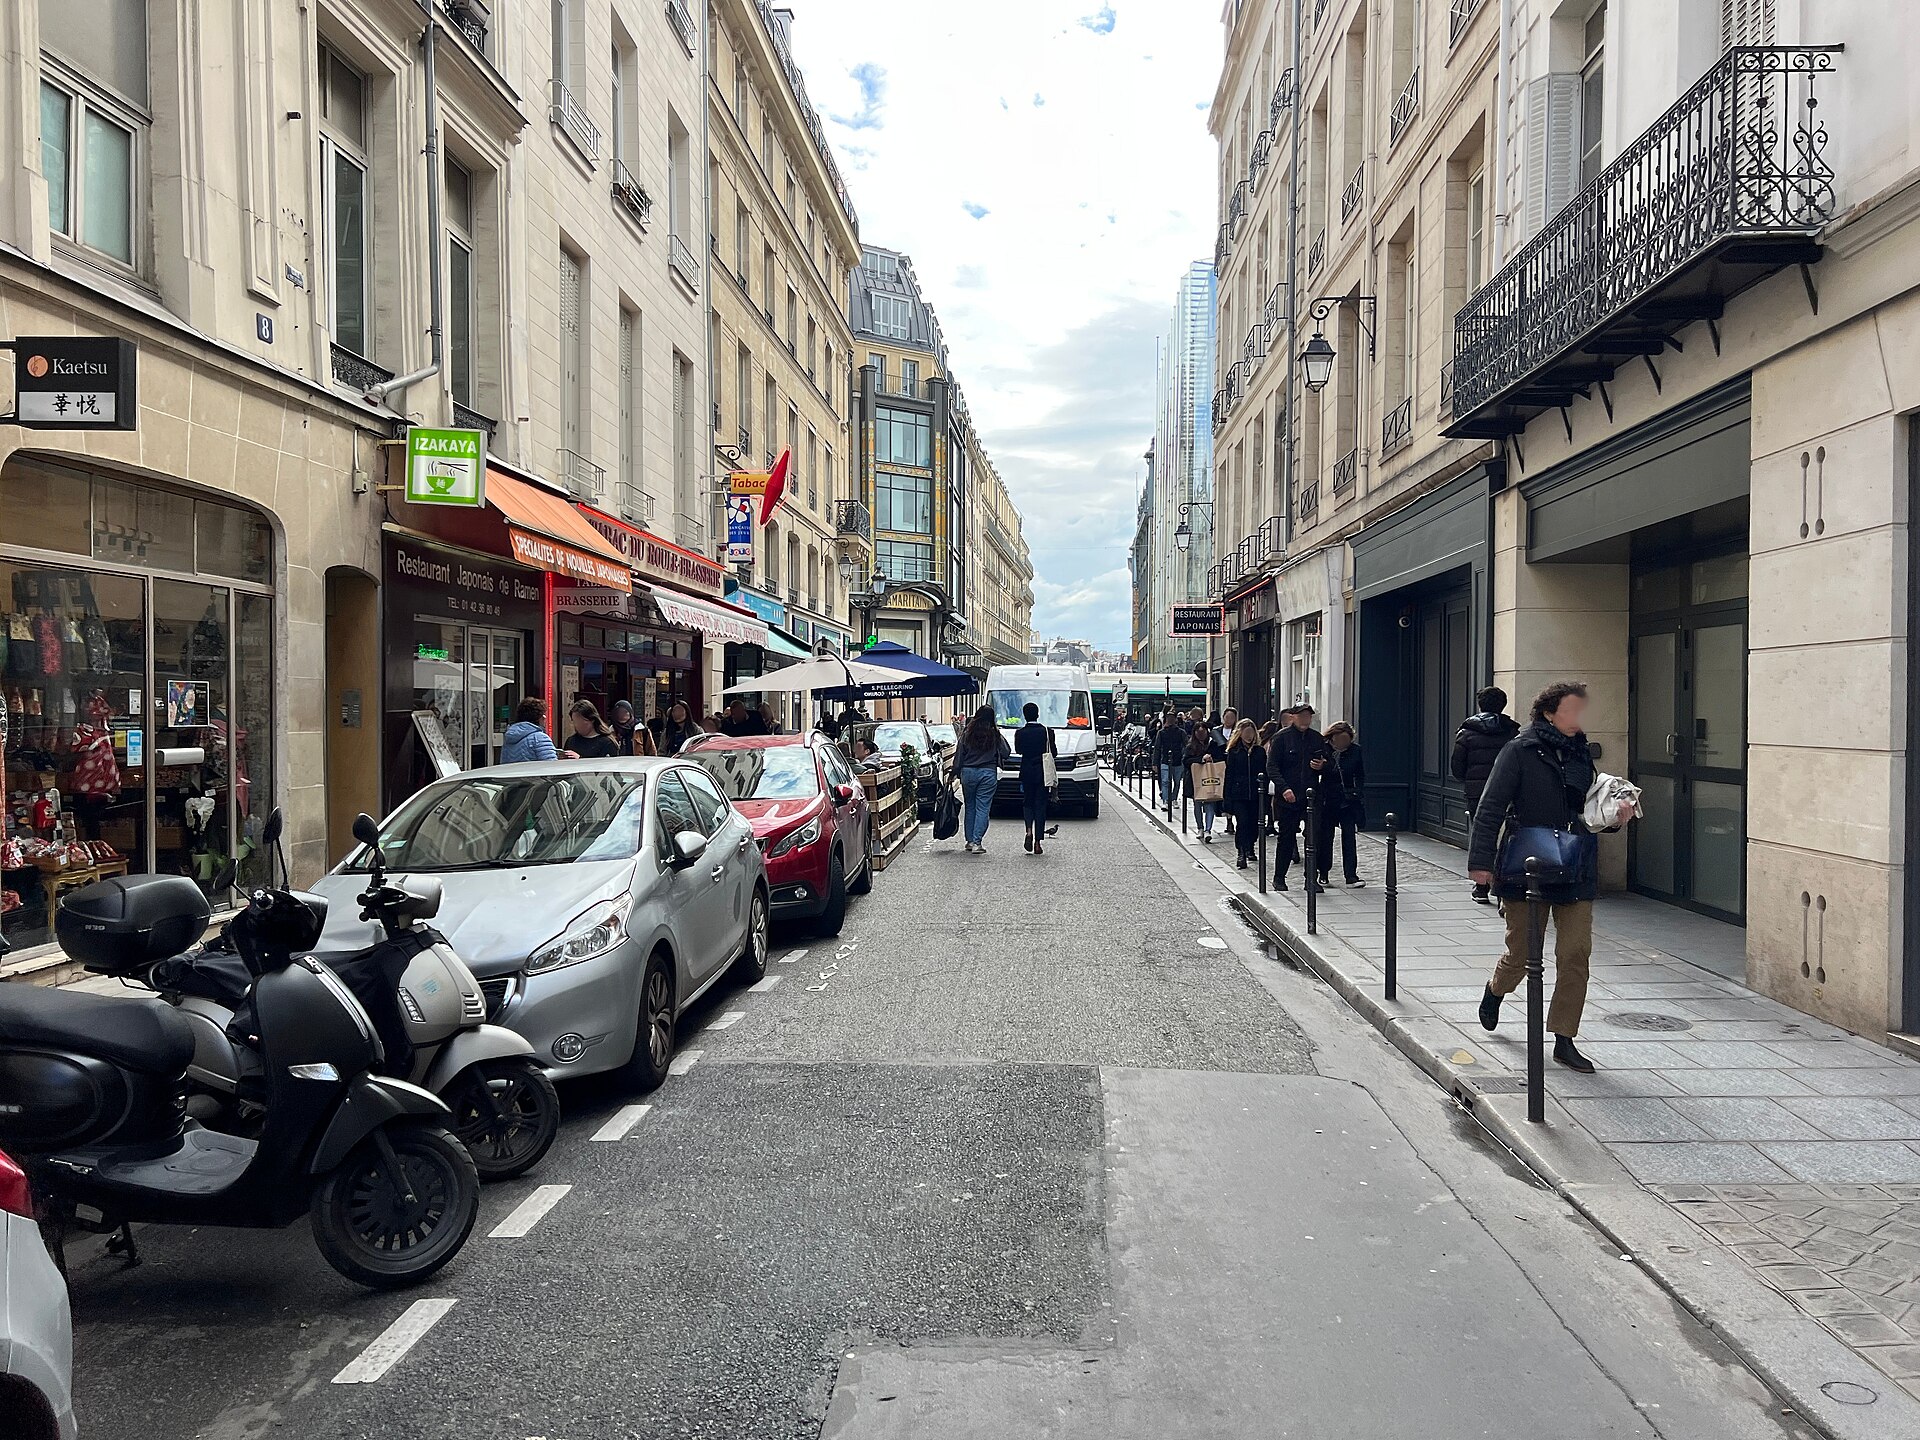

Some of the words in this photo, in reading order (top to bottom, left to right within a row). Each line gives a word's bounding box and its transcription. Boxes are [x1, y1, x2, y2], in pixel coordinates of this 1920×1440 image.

[262, 318, 270, 339] 8
[52, 358, 108, 375] Kaetsu
[415, 437, 477, 454] IZAKAYA
[732, 478, 765, 488] Tabac
[515, 534, 555, 564] SPECIALITES
[556, 548, 565, 567] DE
[566, 553, 596, 577] NOUILLES
[630, 535, 645, 561] DU
[397, 549, 451, 584] Restaurant
[457, 564, 494, 592] Japonais
[499, 576, 509, 595] de
[514, 578, 540, 601] Ramen
[556, 595, 620, 606] BRASSERIE
[1174, 610, 1220, 618] RESTAURANT
[1175, 622, 1220, 630] JAPONAIS
